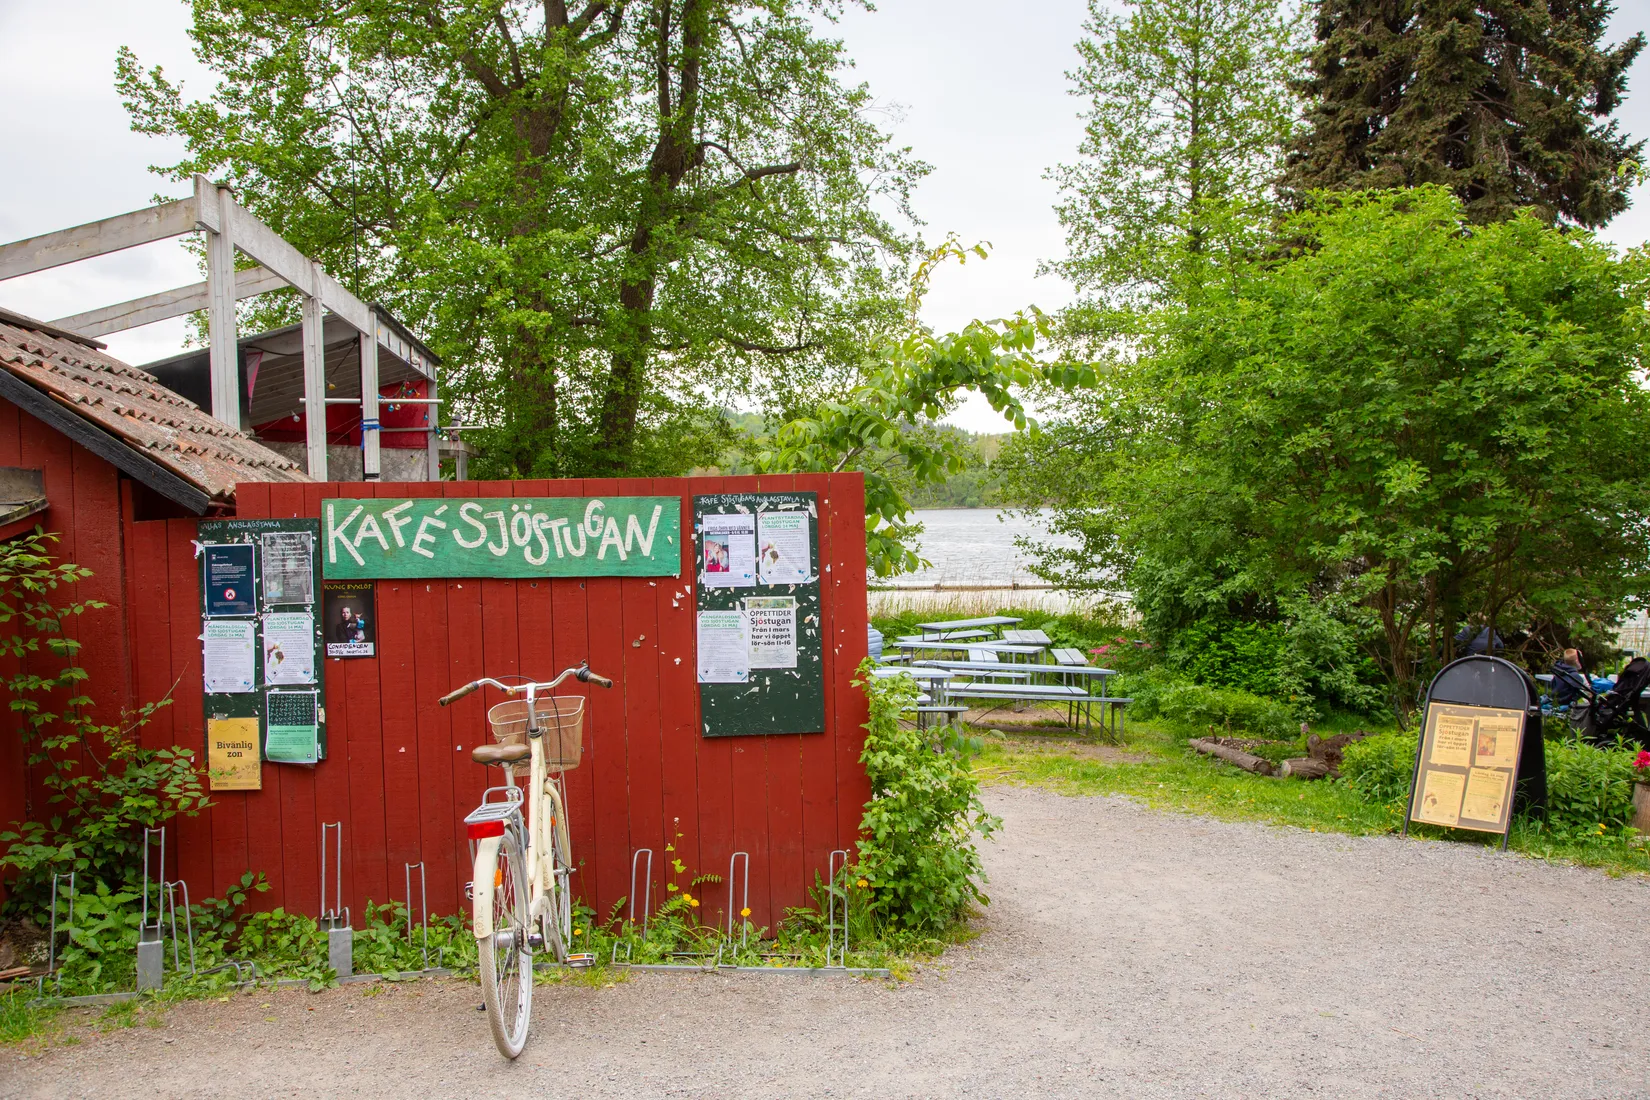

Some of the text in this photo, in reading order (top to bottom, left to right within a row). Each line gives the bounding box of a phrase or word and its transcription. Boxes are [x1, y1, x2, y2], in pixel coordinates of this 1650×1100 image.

[701, 495, 719, 506] KAFÉ
[327, 500, 449, 567] KAFÉ
[452, 499, 663, 567] SJÖSTUGAN
[750, 617, 791, 626] Sjöstugan
[216, 741, 253, 751] Bivänlig
